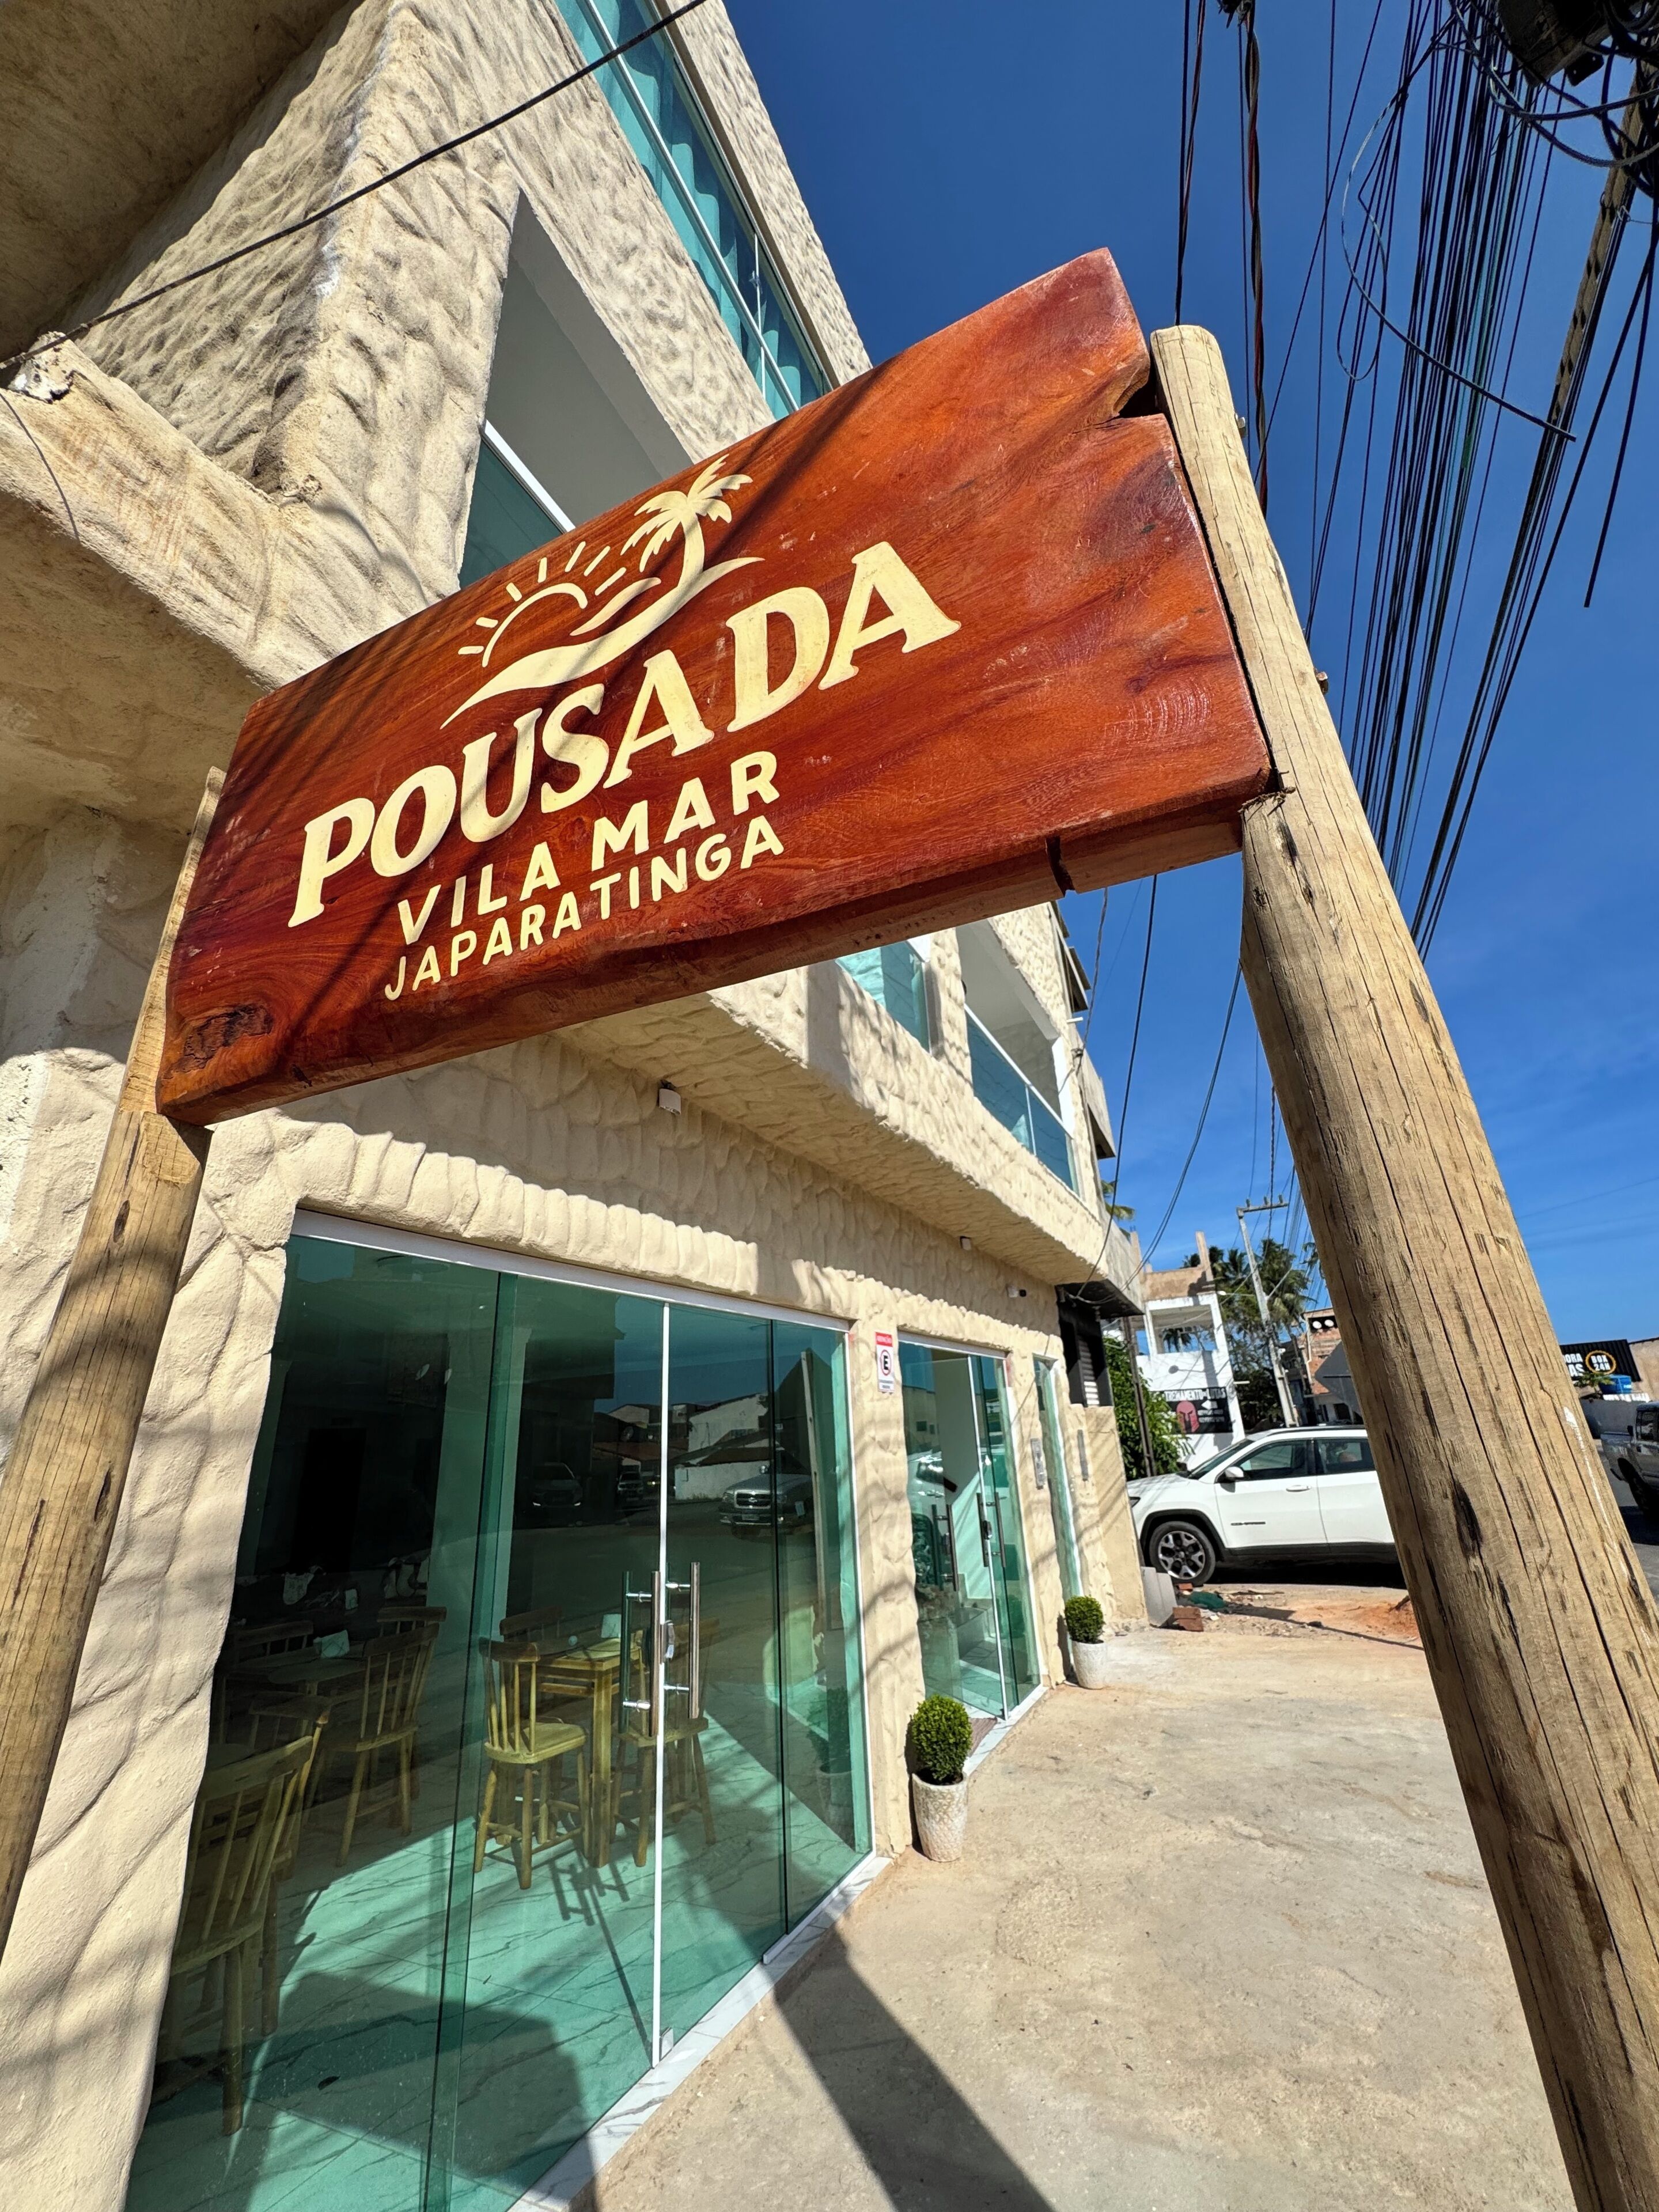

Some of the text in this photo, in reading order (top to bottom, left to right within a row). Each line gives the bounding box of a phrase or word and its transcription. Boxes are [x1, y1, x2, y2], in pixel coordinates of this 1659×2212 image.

[288, 541, 961, 928] POUSADA
[398, 751, 779, 945] VILA MAR
[385, 816, 784, 1000] JAPARATINGA
[884, 1355, 889, 1370] E
[1590, 1355, 1608, 1363] BOX
[1594, 1363, 1611, 1371] 24H
